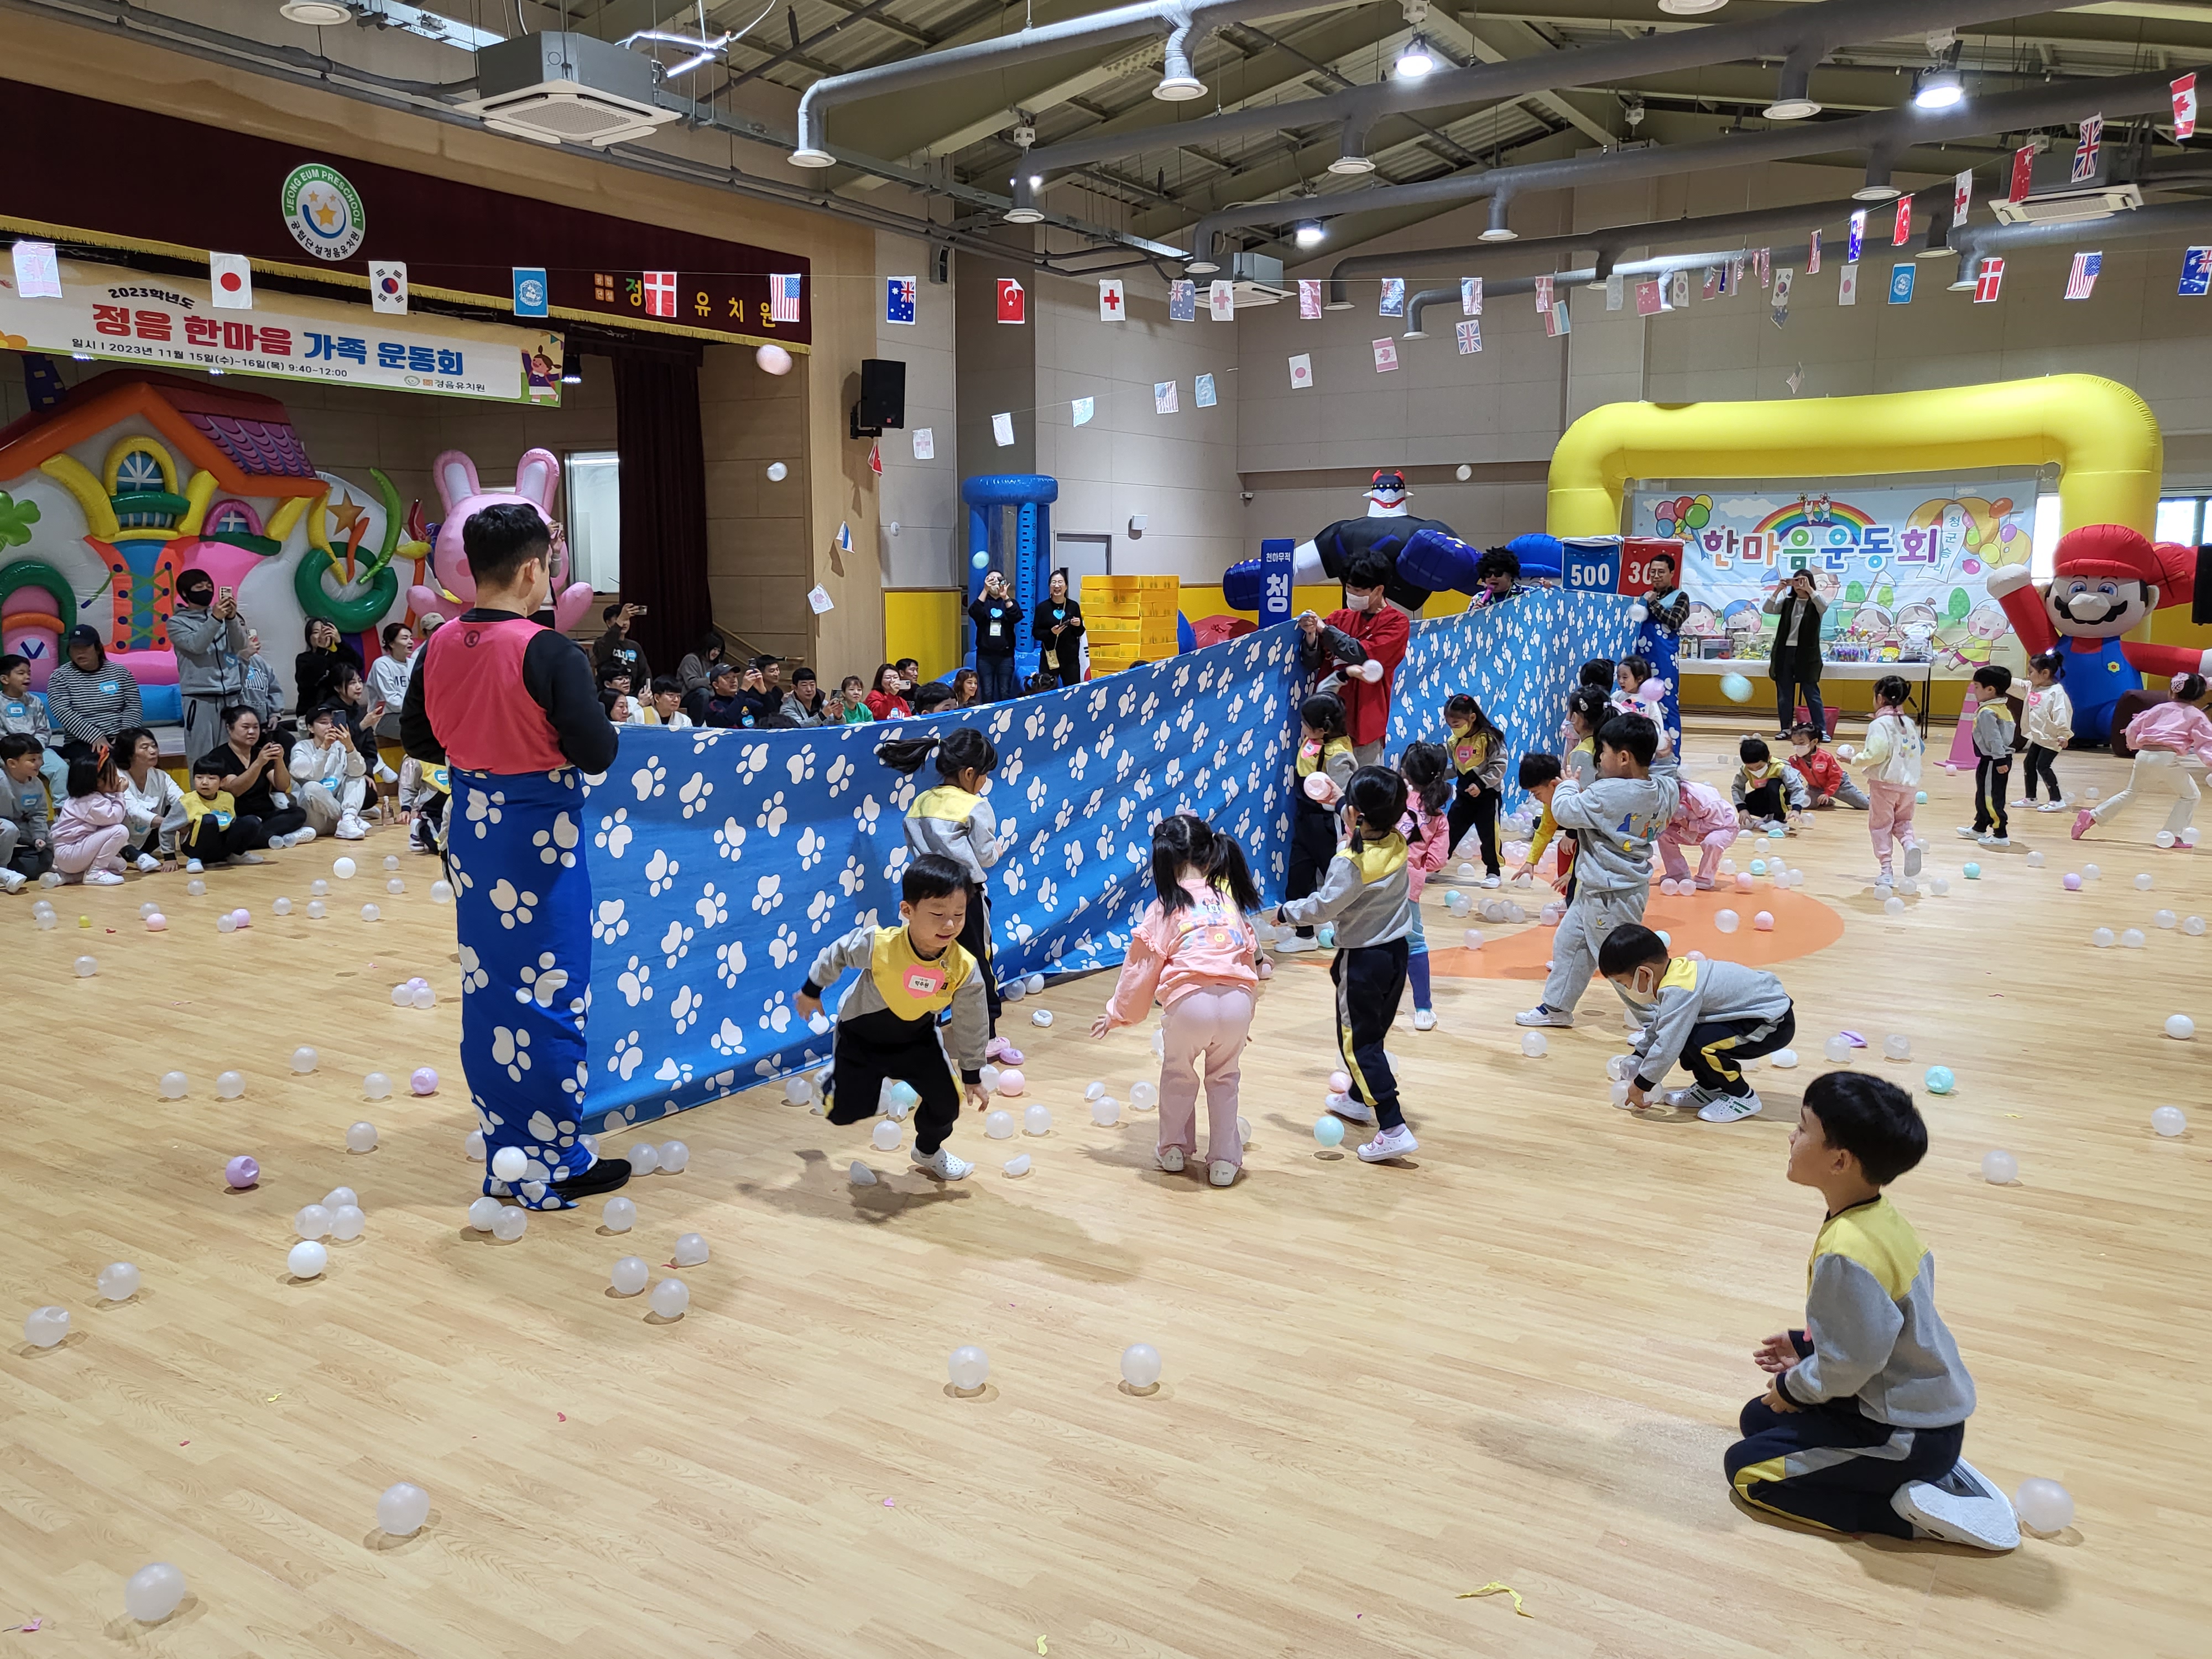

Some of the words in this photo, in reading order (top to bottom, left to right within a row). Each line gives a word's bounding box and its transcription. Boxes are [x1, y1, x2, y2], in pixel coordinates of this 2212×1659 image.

[287, 178, 302, 211] JEONG
[300, 169, 320, 181] EUM
[321, 170, 361, 223] PRESCHOOL
[108, 288, 195, 310] 2023학년도
[92, 304, 173, 342] 정음
[184, 315, 293, 356] 한마음
[304, 332, 367, 365] 가족
[377, 342, 464, 376] 운동회
[72, 338, 96, 349] 일시
[109, 343, 153, 356] 2023년
[158, 349, 184, 359] 11월
[189, 352, 284, 371] 15일(수)~16일(목)
[289, 363, 348, 377] 9:40~12:00
[434, 379, 486, 393] 정음유치원
[1031, 536, 1036, 545] 8
[1703, 528, 1937, 570] 한마음운동회
[1266, 552, 1291, 563] 천하무적
[1571, 563, 1610, 587] 500
[1266, 573, 1288, 613] 청
